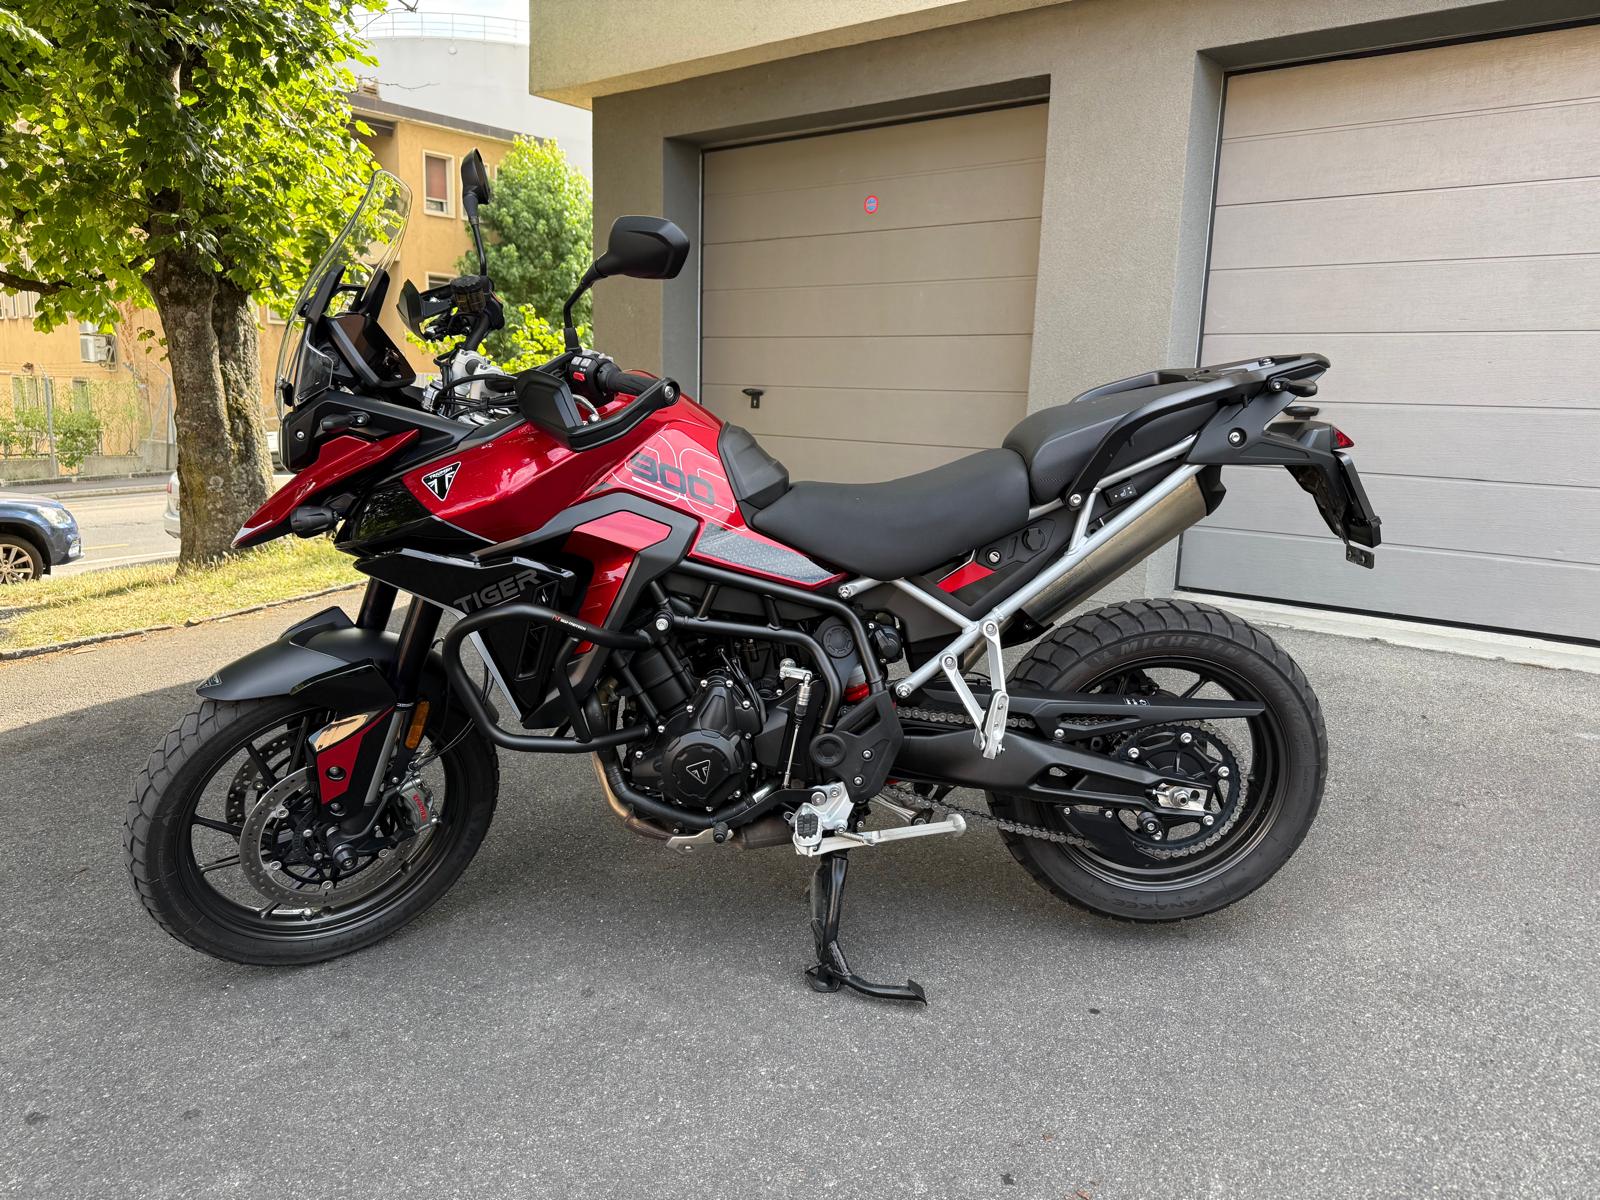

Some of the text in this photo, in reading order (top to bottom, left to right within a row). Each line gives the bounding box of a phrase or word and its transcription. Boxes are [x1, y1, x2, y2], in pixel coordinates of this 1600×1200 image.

[630, 453, 715, 505] 900
[453, 569, 541, 614] TIGER
[1120, 635, 1240, 657] MICHELIN
